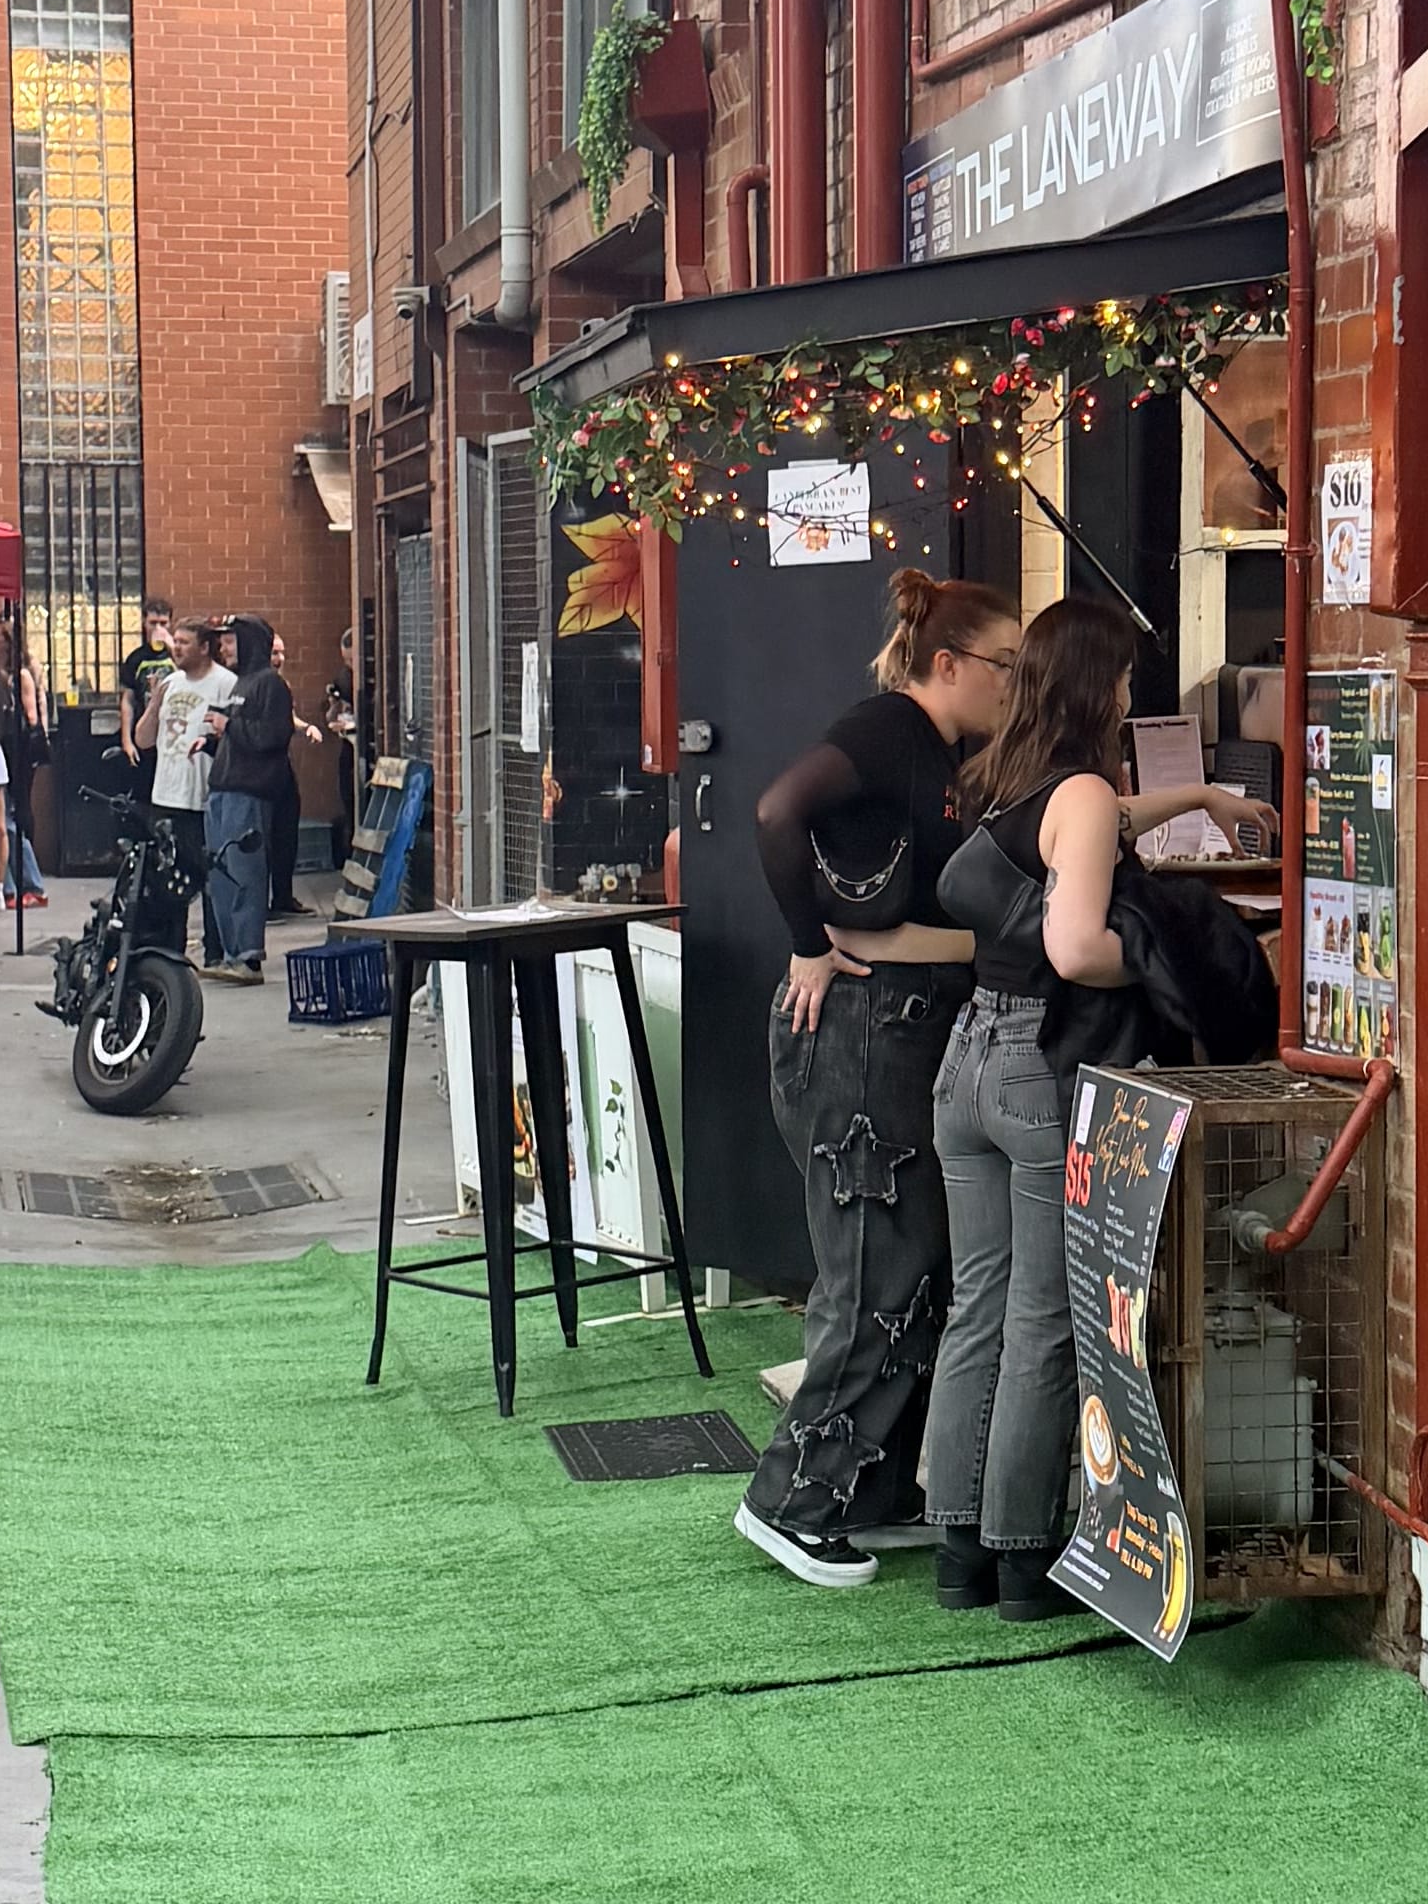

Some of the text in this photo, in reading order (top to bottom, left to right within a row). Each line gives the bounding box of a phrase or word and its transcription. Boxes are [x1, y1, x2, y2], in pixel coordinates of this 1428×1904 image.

[956, 133, 1015, 240] THE
[1021, 32, 1198, 212] LANEWAY
[1329, 469, 1362, 509] $10
[1064, 1138, 1095, 1208] $15
